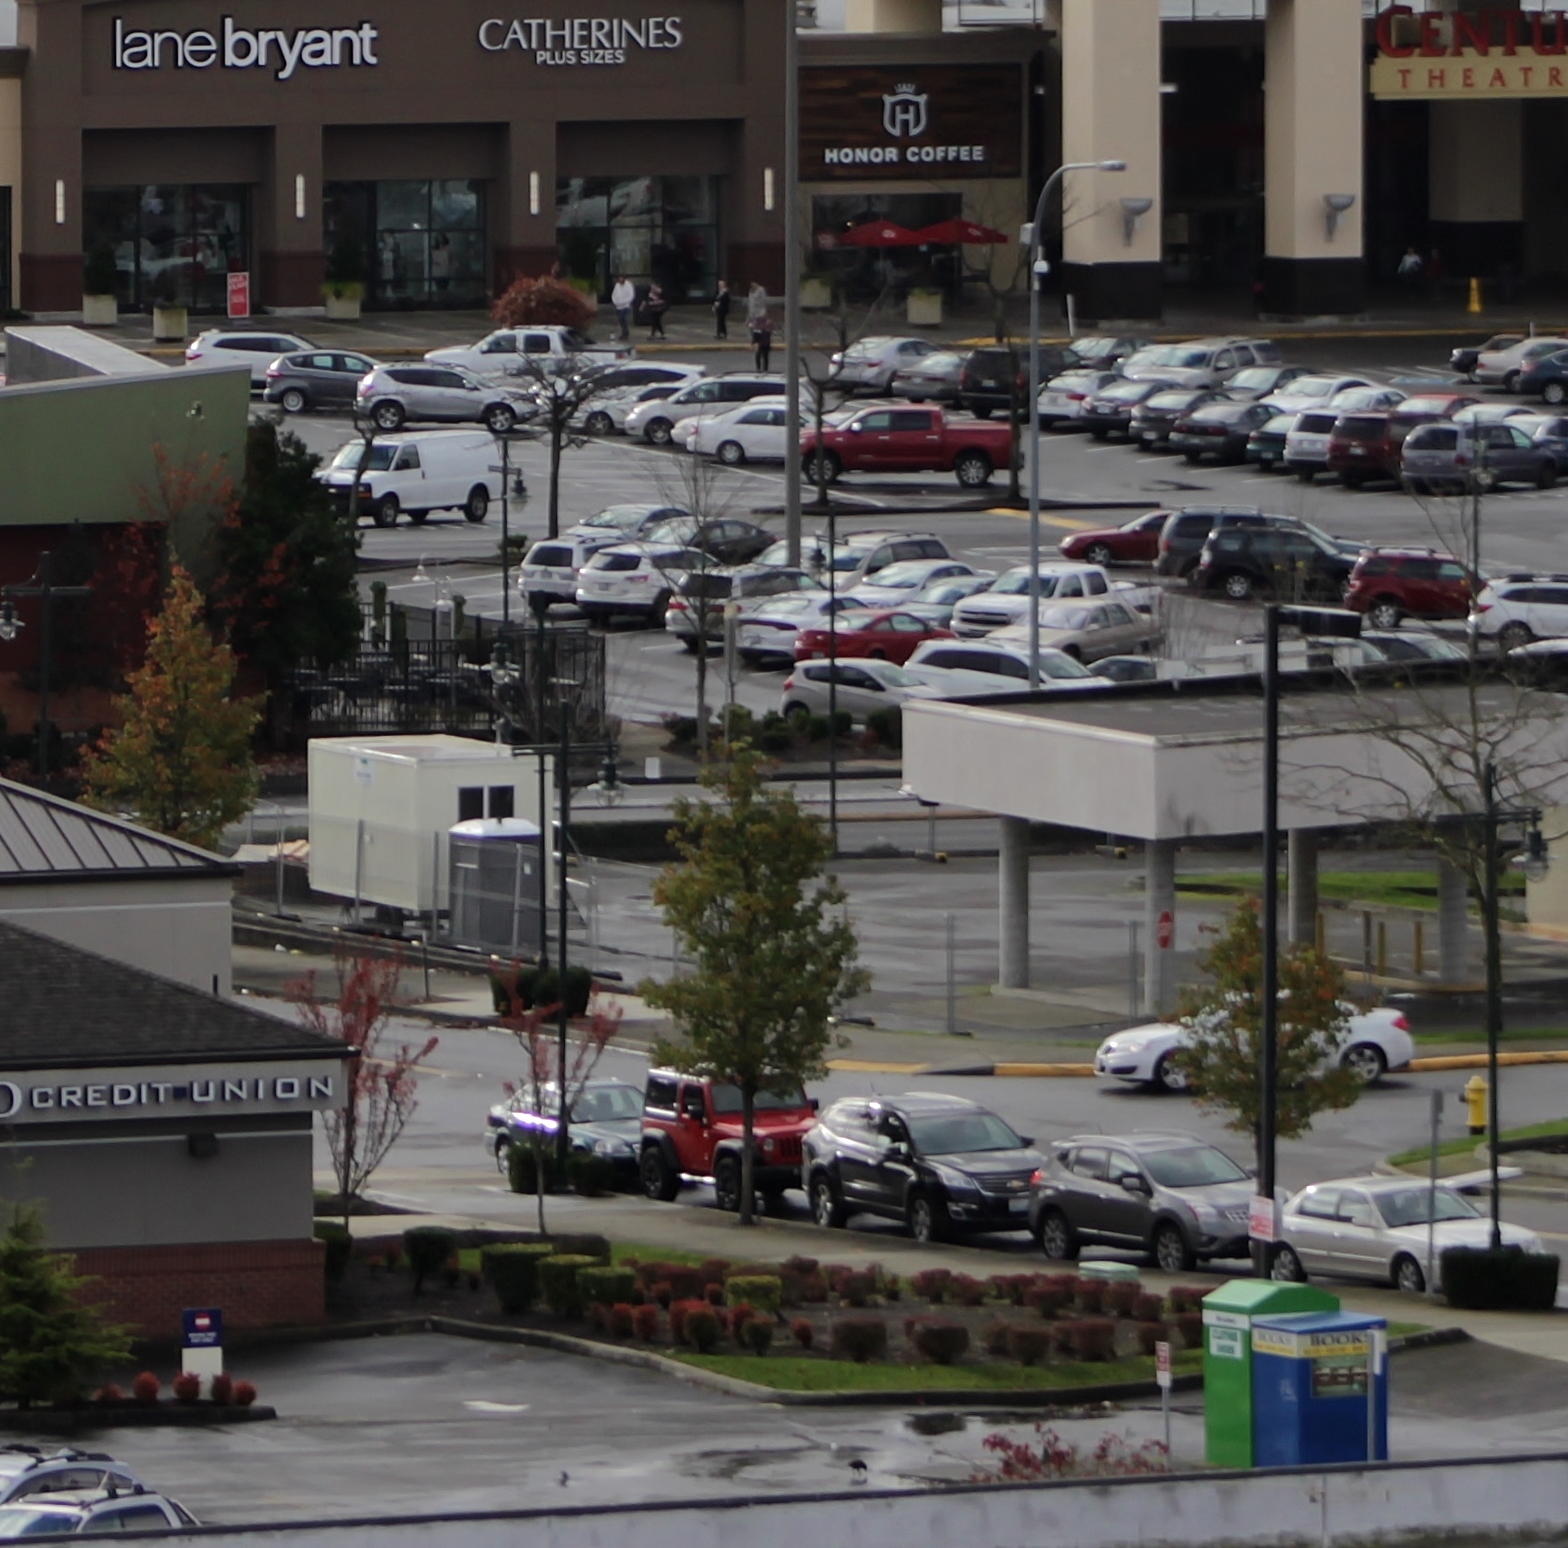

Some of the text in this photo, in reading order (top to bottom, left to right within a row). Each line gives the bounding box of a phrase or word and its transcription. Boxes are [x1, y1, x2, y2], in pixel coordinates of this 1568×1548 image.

[115, 17, 377, 79] lane bryant
[479, 17, 683, 50] CATHERINES
[536, 49, 625, 65] PLUS SIZES
[824, 145, 985, 163] HONOR COFFEE
[31, 1082, 172, 1109] CREDIT
[191, 1076, 333, 1103] UNION
